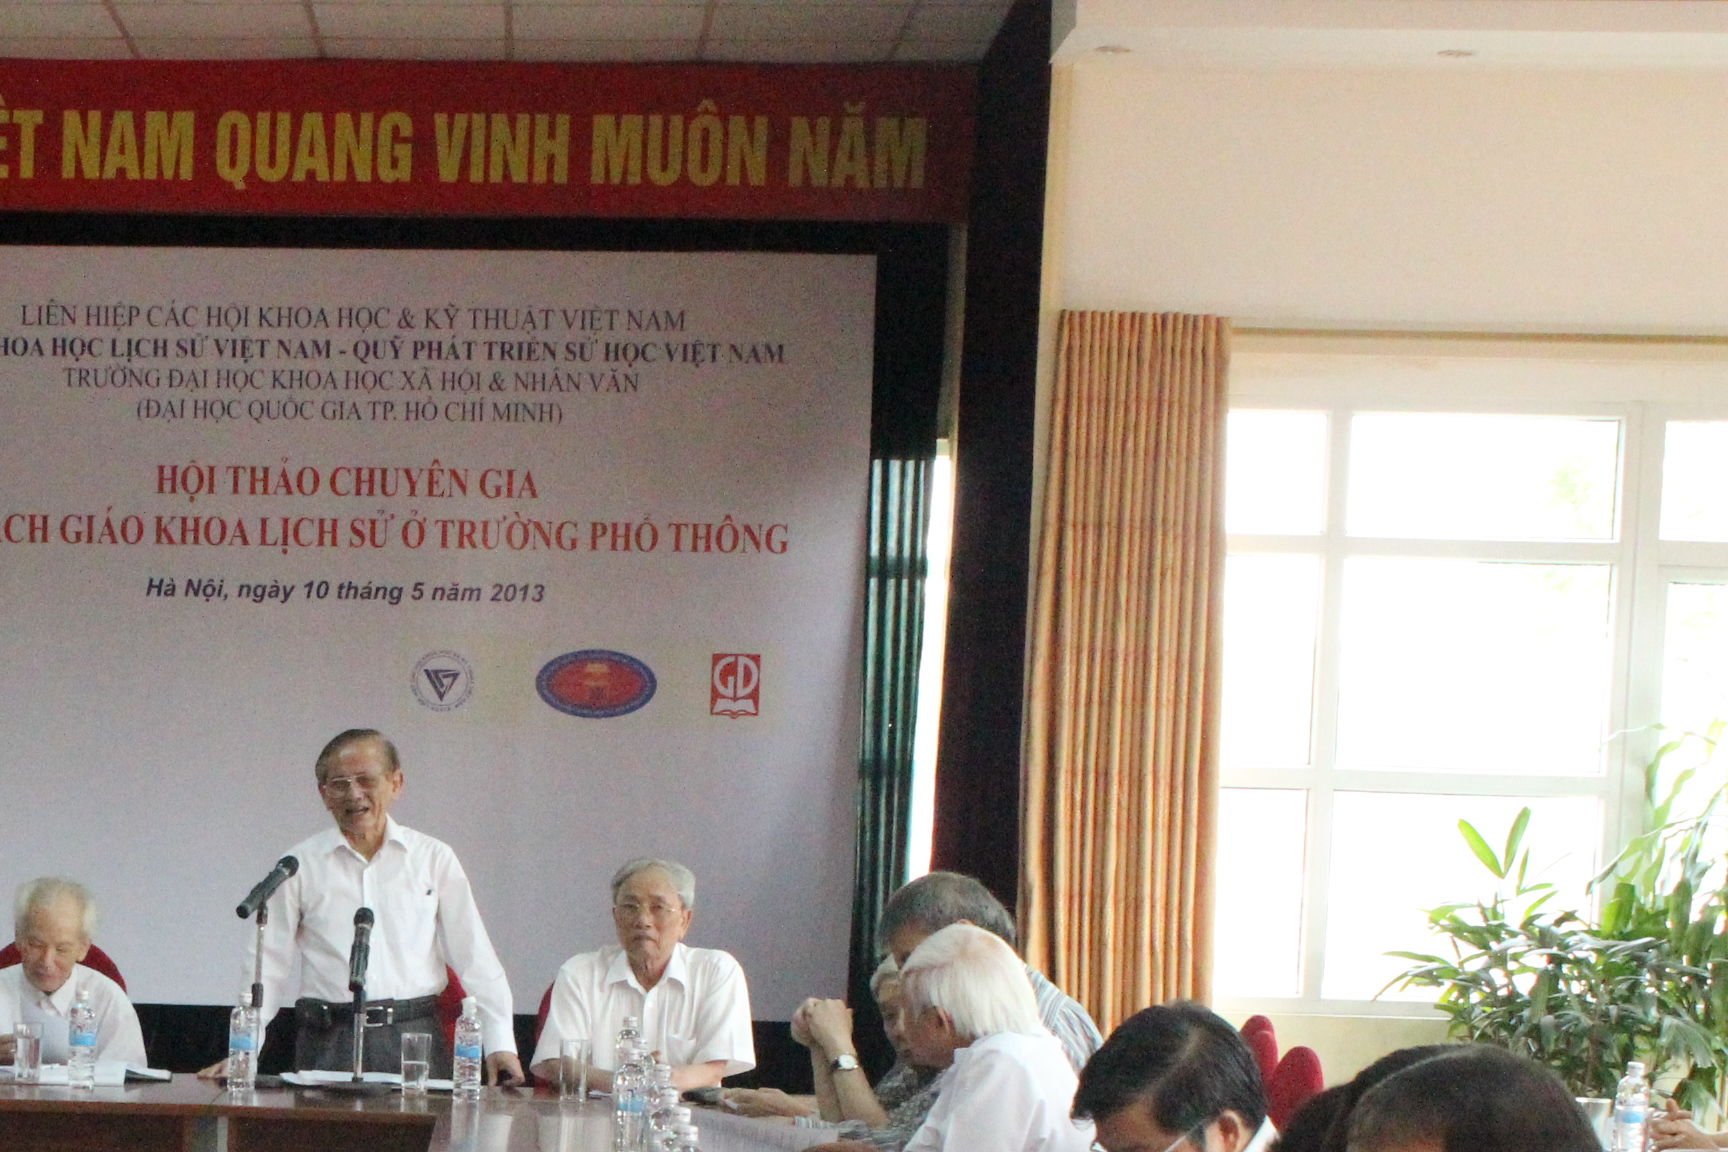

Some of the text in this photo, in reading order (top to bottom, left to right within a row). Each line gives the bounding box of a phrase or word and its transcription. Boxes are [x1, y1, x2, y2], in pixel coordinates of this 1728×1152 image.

[62, 110, 197, 181] NAM
[214, 110, 414, 192] QUANG
[434, 113, 571, 186] VINH
[590, 99, 767, 188] MUÔN
[789, 99, 930, 189] NĂM
[21, 298, 685, 335] LIÊN HIỆP CÁC HỘI KHOA HỌC & KỸ THUẬT VIỆT NAM
[52, 337, 104, 362] HỌC
[110, 338, 168, 363] LỊCH
[214, 337, 270, 364] VIỆT
[277, 339, 331, 359] NAM
[353, 334, 404, 363] QUỸ
[412, 335, 477, 360] PHÁT
[604, 342, 663, 367] HỌC
[665, 340, 721, 368] VIỆT
[728, 343, 785, 364] NAM
[168, 368, 208, 392] ĐẠI
[216, 369, 265, 393] HỌC
[272, 370, 339, 390] KHOA
[344, 371, 395, 395] HỌC
[400, 367, 433, 390] XÃ
[441, 368, 480, 394] HỘI
[488, 371, 506, 391] &
[514, 367, 581, 392] NHÂN
[589, 369, 639, 393] VĂN
[137, 398, 185, 422] (ĐẠI
[193, 400, 242, 423] HỌC
[321, 401, 362, 422] GIA
[367, 402, 397, 422] TP.
[445, 398, 484, 422] CHÍ
[492, 402, 563, 424] MINH)
[156, 457, 539, 503] HỘI THẢO CHUYÊN GIA
[60, 506, 144, 545] GIÁO
[154, 515, 250, 546] KHOA
[259, 517, 339, 556] LỊCH
[349, 509, 396, 548] SỬ
[401, 509, 427, 549] Ở
[435, 511, 578, 551] TRƯỜNG
[590, 513, 660, 553] PHỔ
[668, 513, 789, 555] THÔNG
[146, 577, 545, 606] Hà Nội, ngày 10 tháng 5 năm 2013
[714, 655, 760, 698] GD
